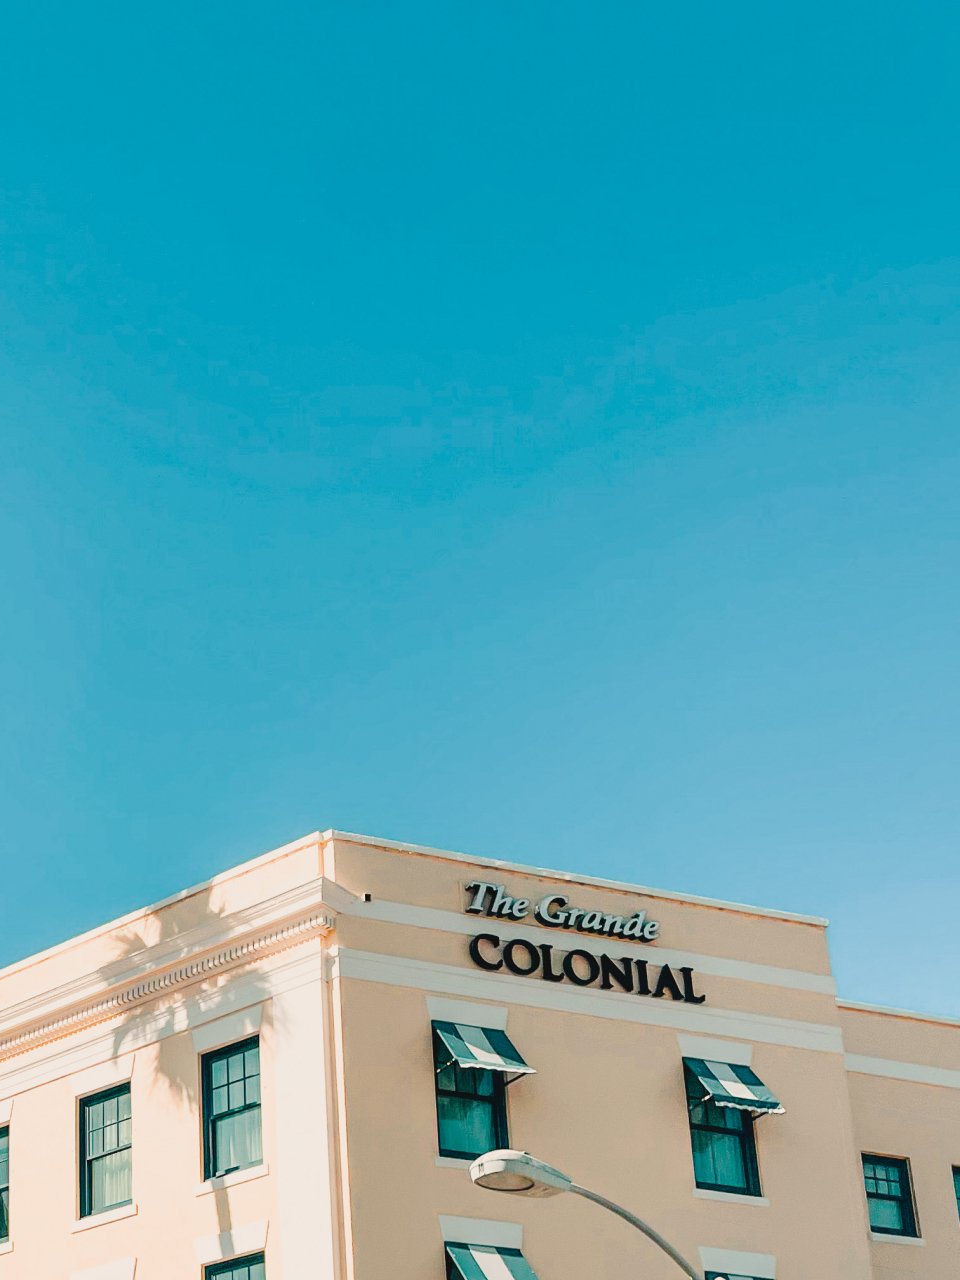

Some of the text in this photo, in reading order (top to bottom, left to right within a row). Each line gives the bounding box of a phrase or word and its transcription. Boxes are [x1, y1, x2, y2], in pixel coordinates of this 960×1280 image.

[465, 881, 660, 942] The Grande
[469, 934, 706, 1003] COLONIAL
